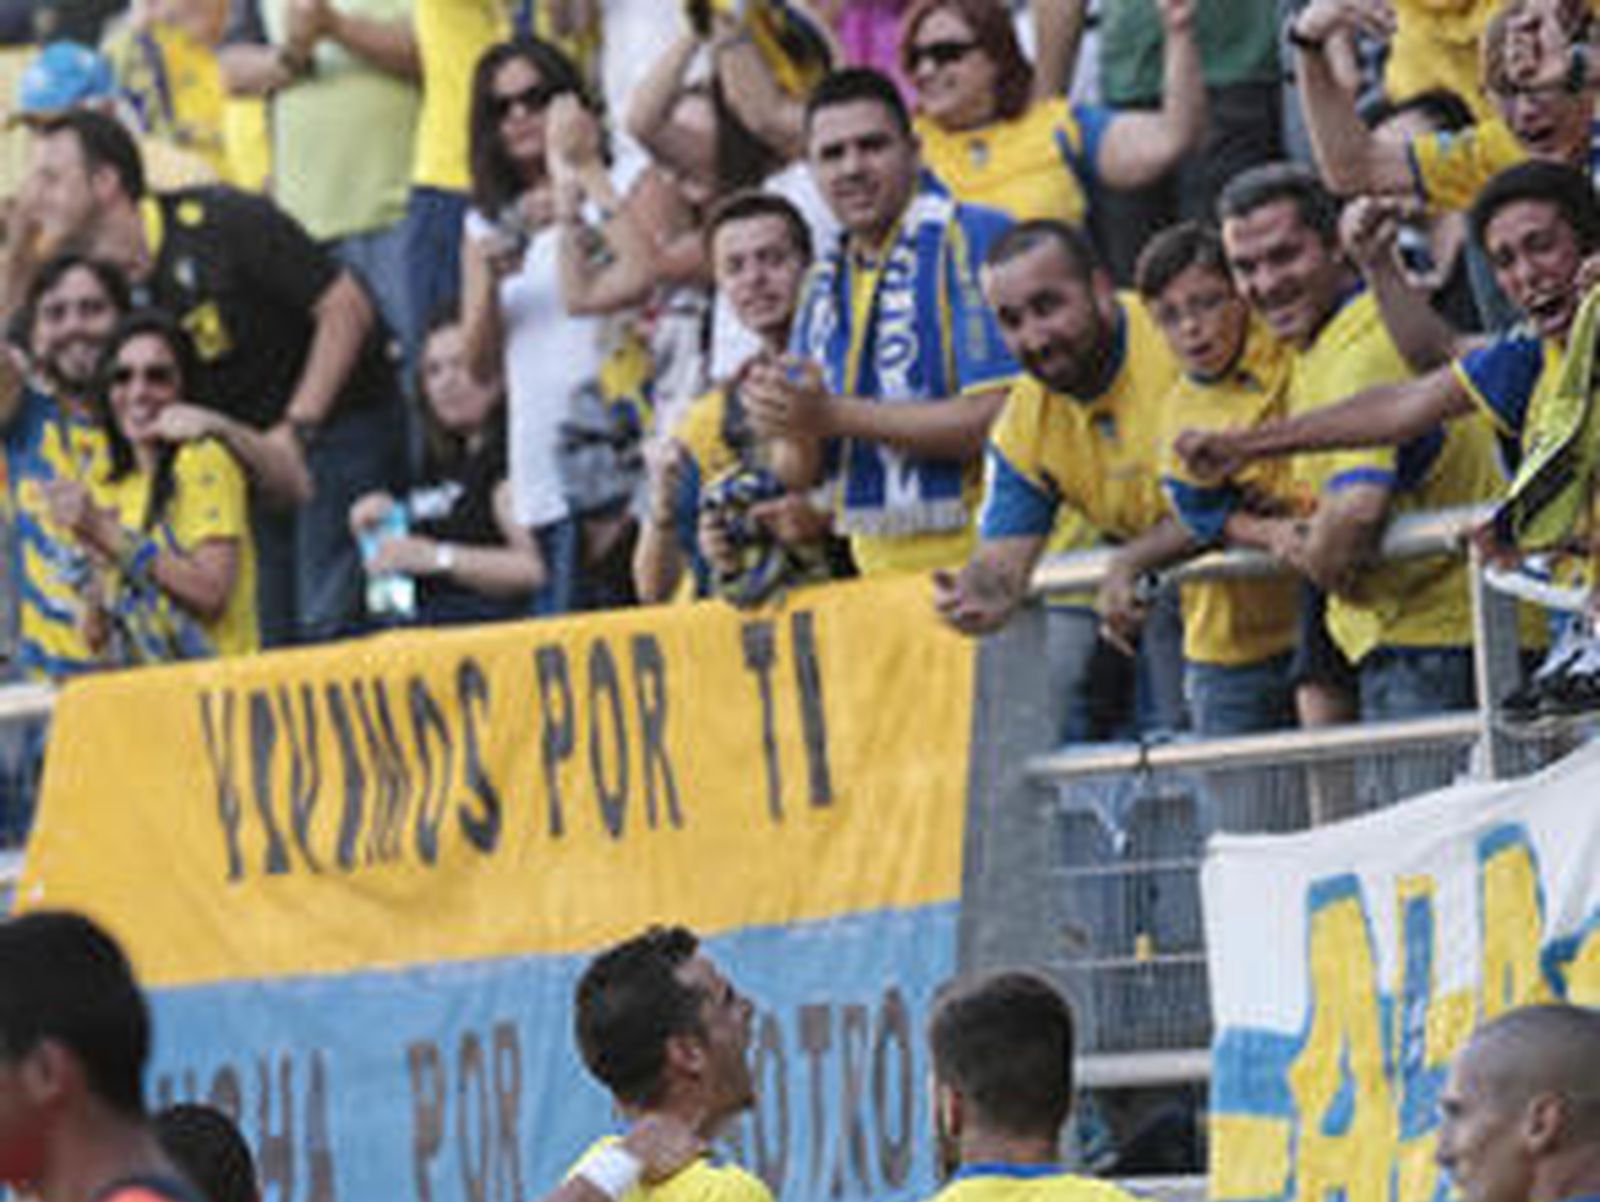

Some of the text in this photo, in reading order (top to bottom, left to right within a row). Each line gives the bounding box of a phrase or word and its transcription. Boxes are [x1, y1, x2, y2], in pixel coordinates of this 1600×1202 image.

[199, 610, 832, 884] VIVIMOS POR TI
